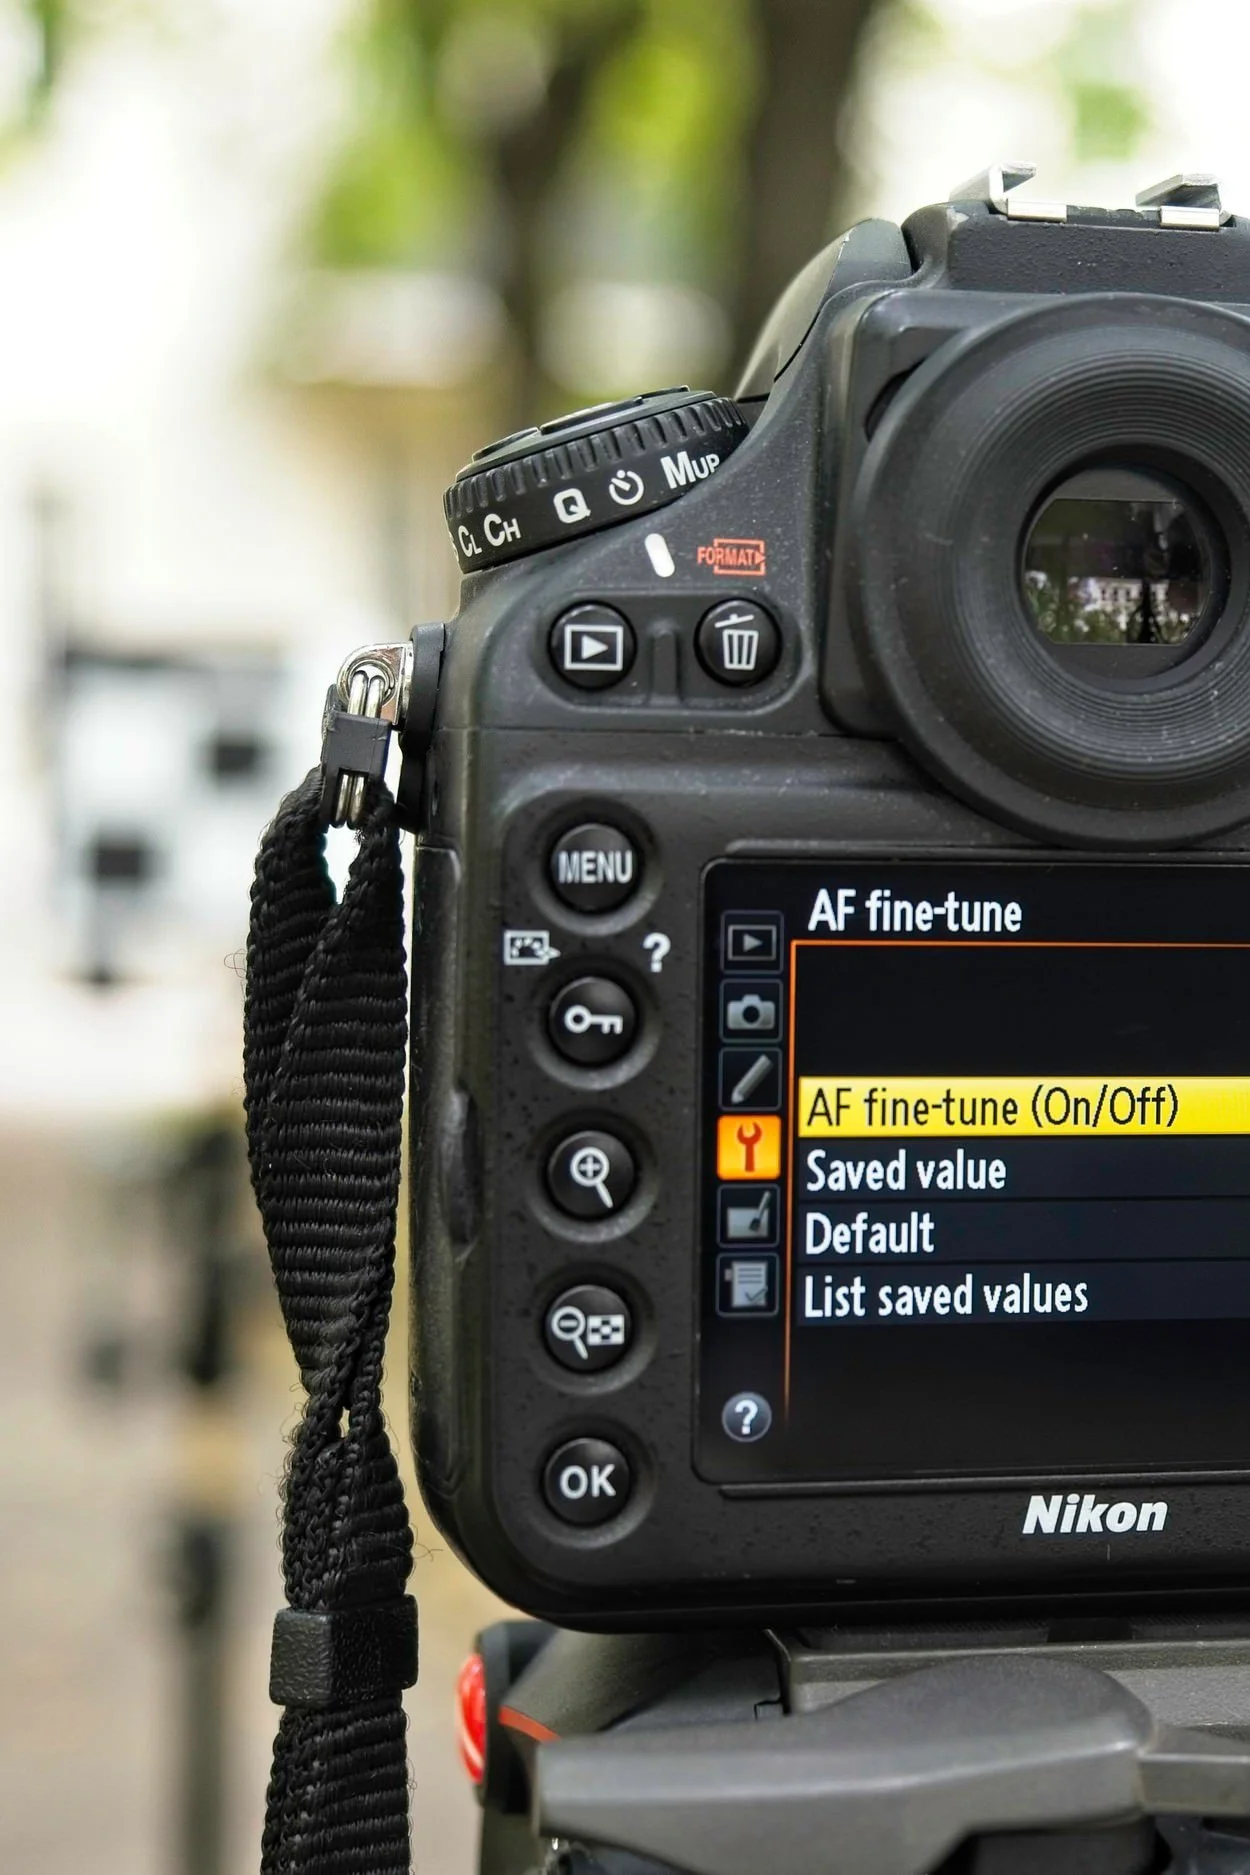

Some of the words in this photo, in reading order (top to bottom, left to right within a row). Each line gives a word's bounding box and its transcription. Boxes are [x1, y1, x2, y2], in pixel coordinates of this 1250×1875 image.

[697, 546, 754, 566] FORMAT
[558, 851, 633, 883] MENU
[807, 888, 857, 932] AF
[864, 889, 1022, 932] fine-tune
[807, 1086, 852, 1127] AF
[863, 1087, 1018, 1126] fine-tune
[1031, 1083, 1179, 1128] (On/Off)
[806, 1148, 907, 1192] Saved
[915, 1158, 1007, 1191] value
[805, 1211, 935, 1255] Default
[804, 1274, 867, 1318] List
[878, 1273, 973, 1317] saved
[983, 1272, 1089, 1314] values
[560, 1464, 616, 1499] OK
[1022, 1493, 1168, 1535] Nikon
